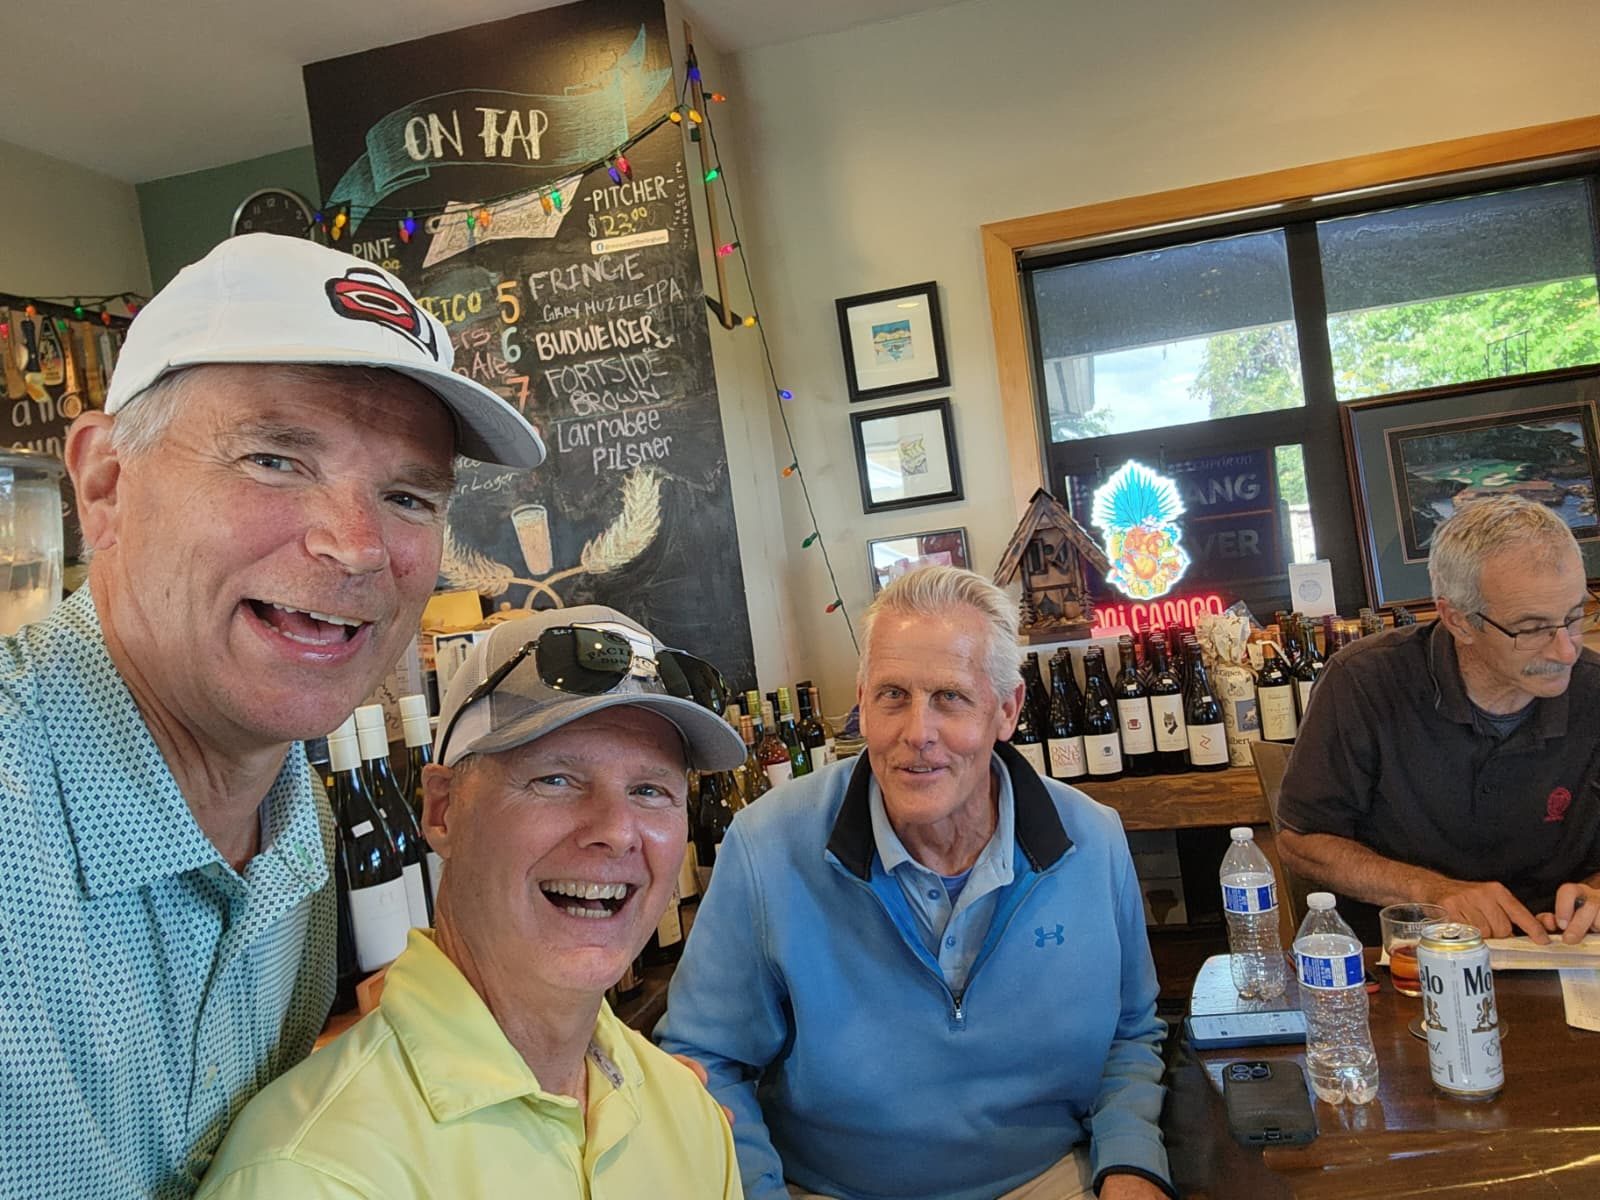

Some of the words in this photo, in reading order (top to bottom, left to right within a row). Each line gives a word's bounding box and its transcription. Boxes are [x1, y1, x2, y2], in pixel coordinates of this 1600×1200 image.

[404, 110, 463, 162] ON
[474, 107, 549, 161] TAP
[528, 252, 644, 301] FRINGE
[643, 277, 684, 309] IPA
[496, 281, 520, 324] 5
[502, 326, 522, 363] 6
[535, 315, 661, 361] BUDWEISER
[506, 376, 531, 415] 7
[545, 349, 669, 398] FORTSIDE
[556, 408, 662, 453] Larrabee
